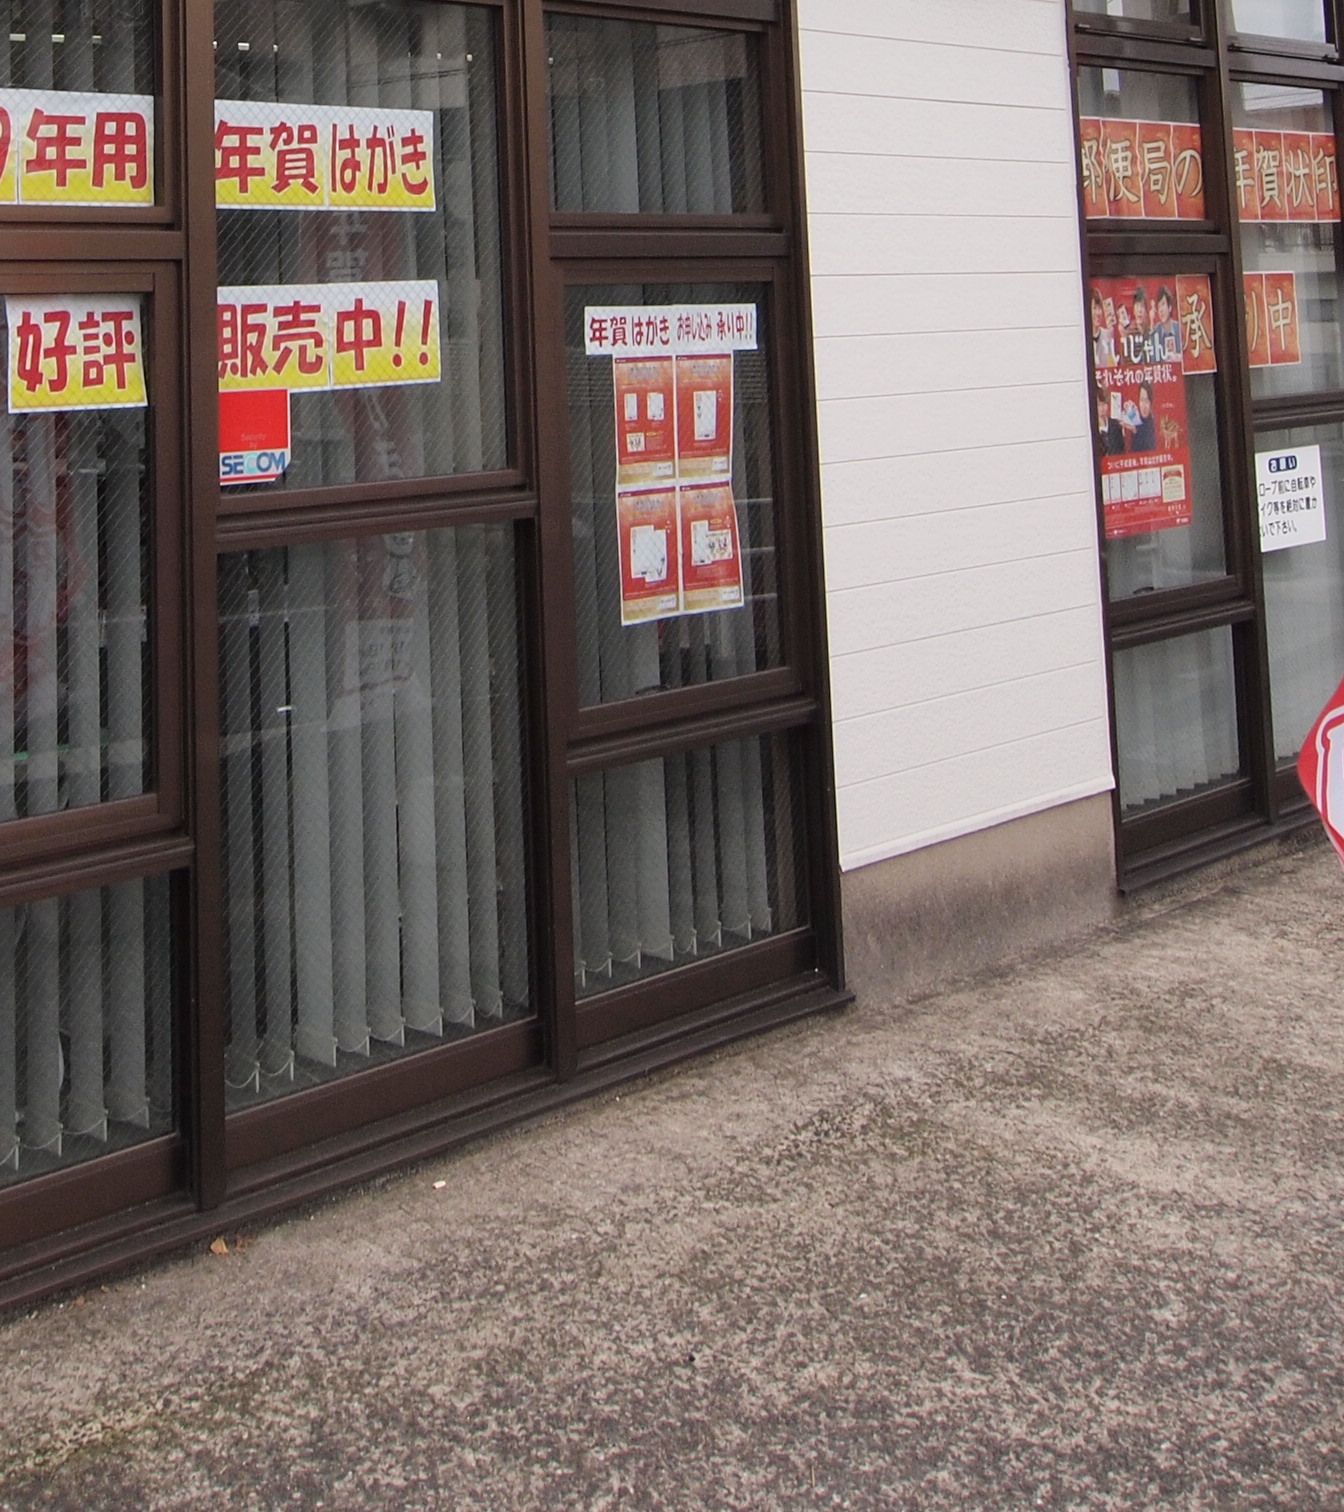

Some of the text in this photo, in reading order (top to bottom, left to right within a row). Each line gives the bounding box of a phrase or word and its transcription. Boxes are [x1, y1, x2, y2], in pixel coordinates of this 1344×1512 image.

[214, 120, 430, 197] 年賀はがき
[16, 310, 138, 394] 好評
[589, 316, 670, 348] 年賀はがき
[1182, 293, 1213, 358] 承
[221, 451, 286, 476] SECOM
